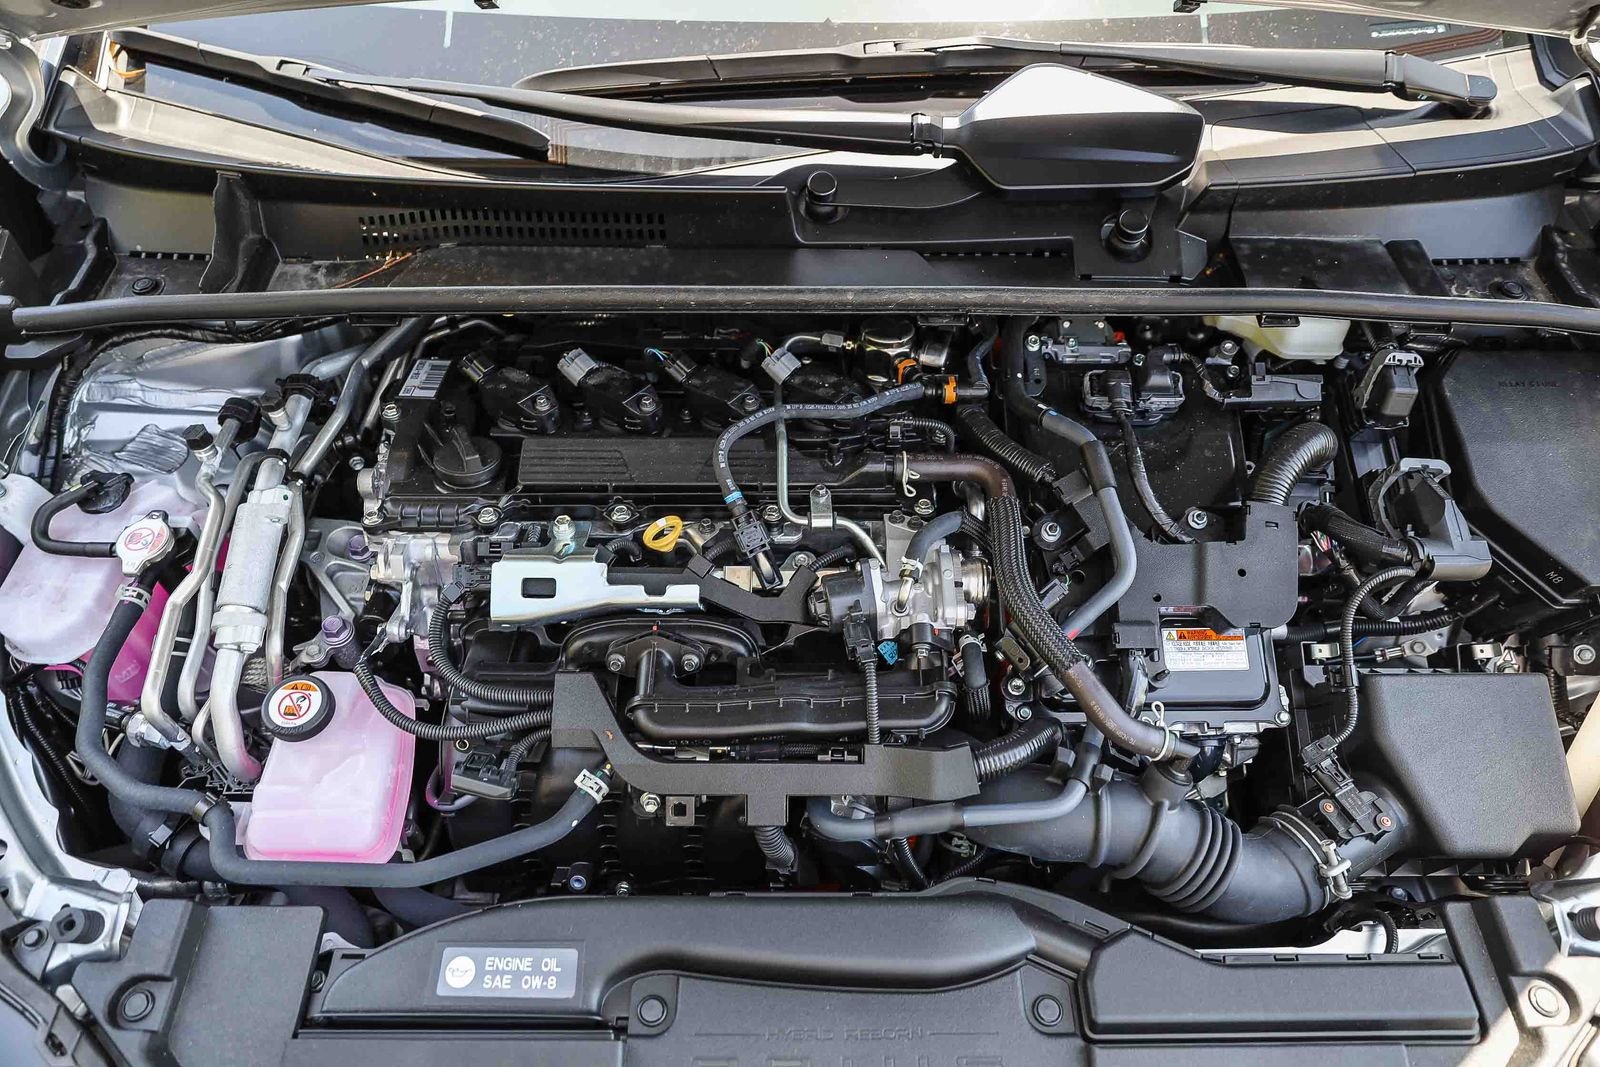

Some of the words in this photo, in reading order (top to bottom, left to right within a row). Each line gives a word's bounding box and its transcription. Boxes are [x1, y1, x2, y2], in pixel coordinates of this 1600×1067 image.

[484, 956, 533, 972] ENGINE
[541, 957, 562, 973] OIL
[482, 974, 513, 990] SAE
